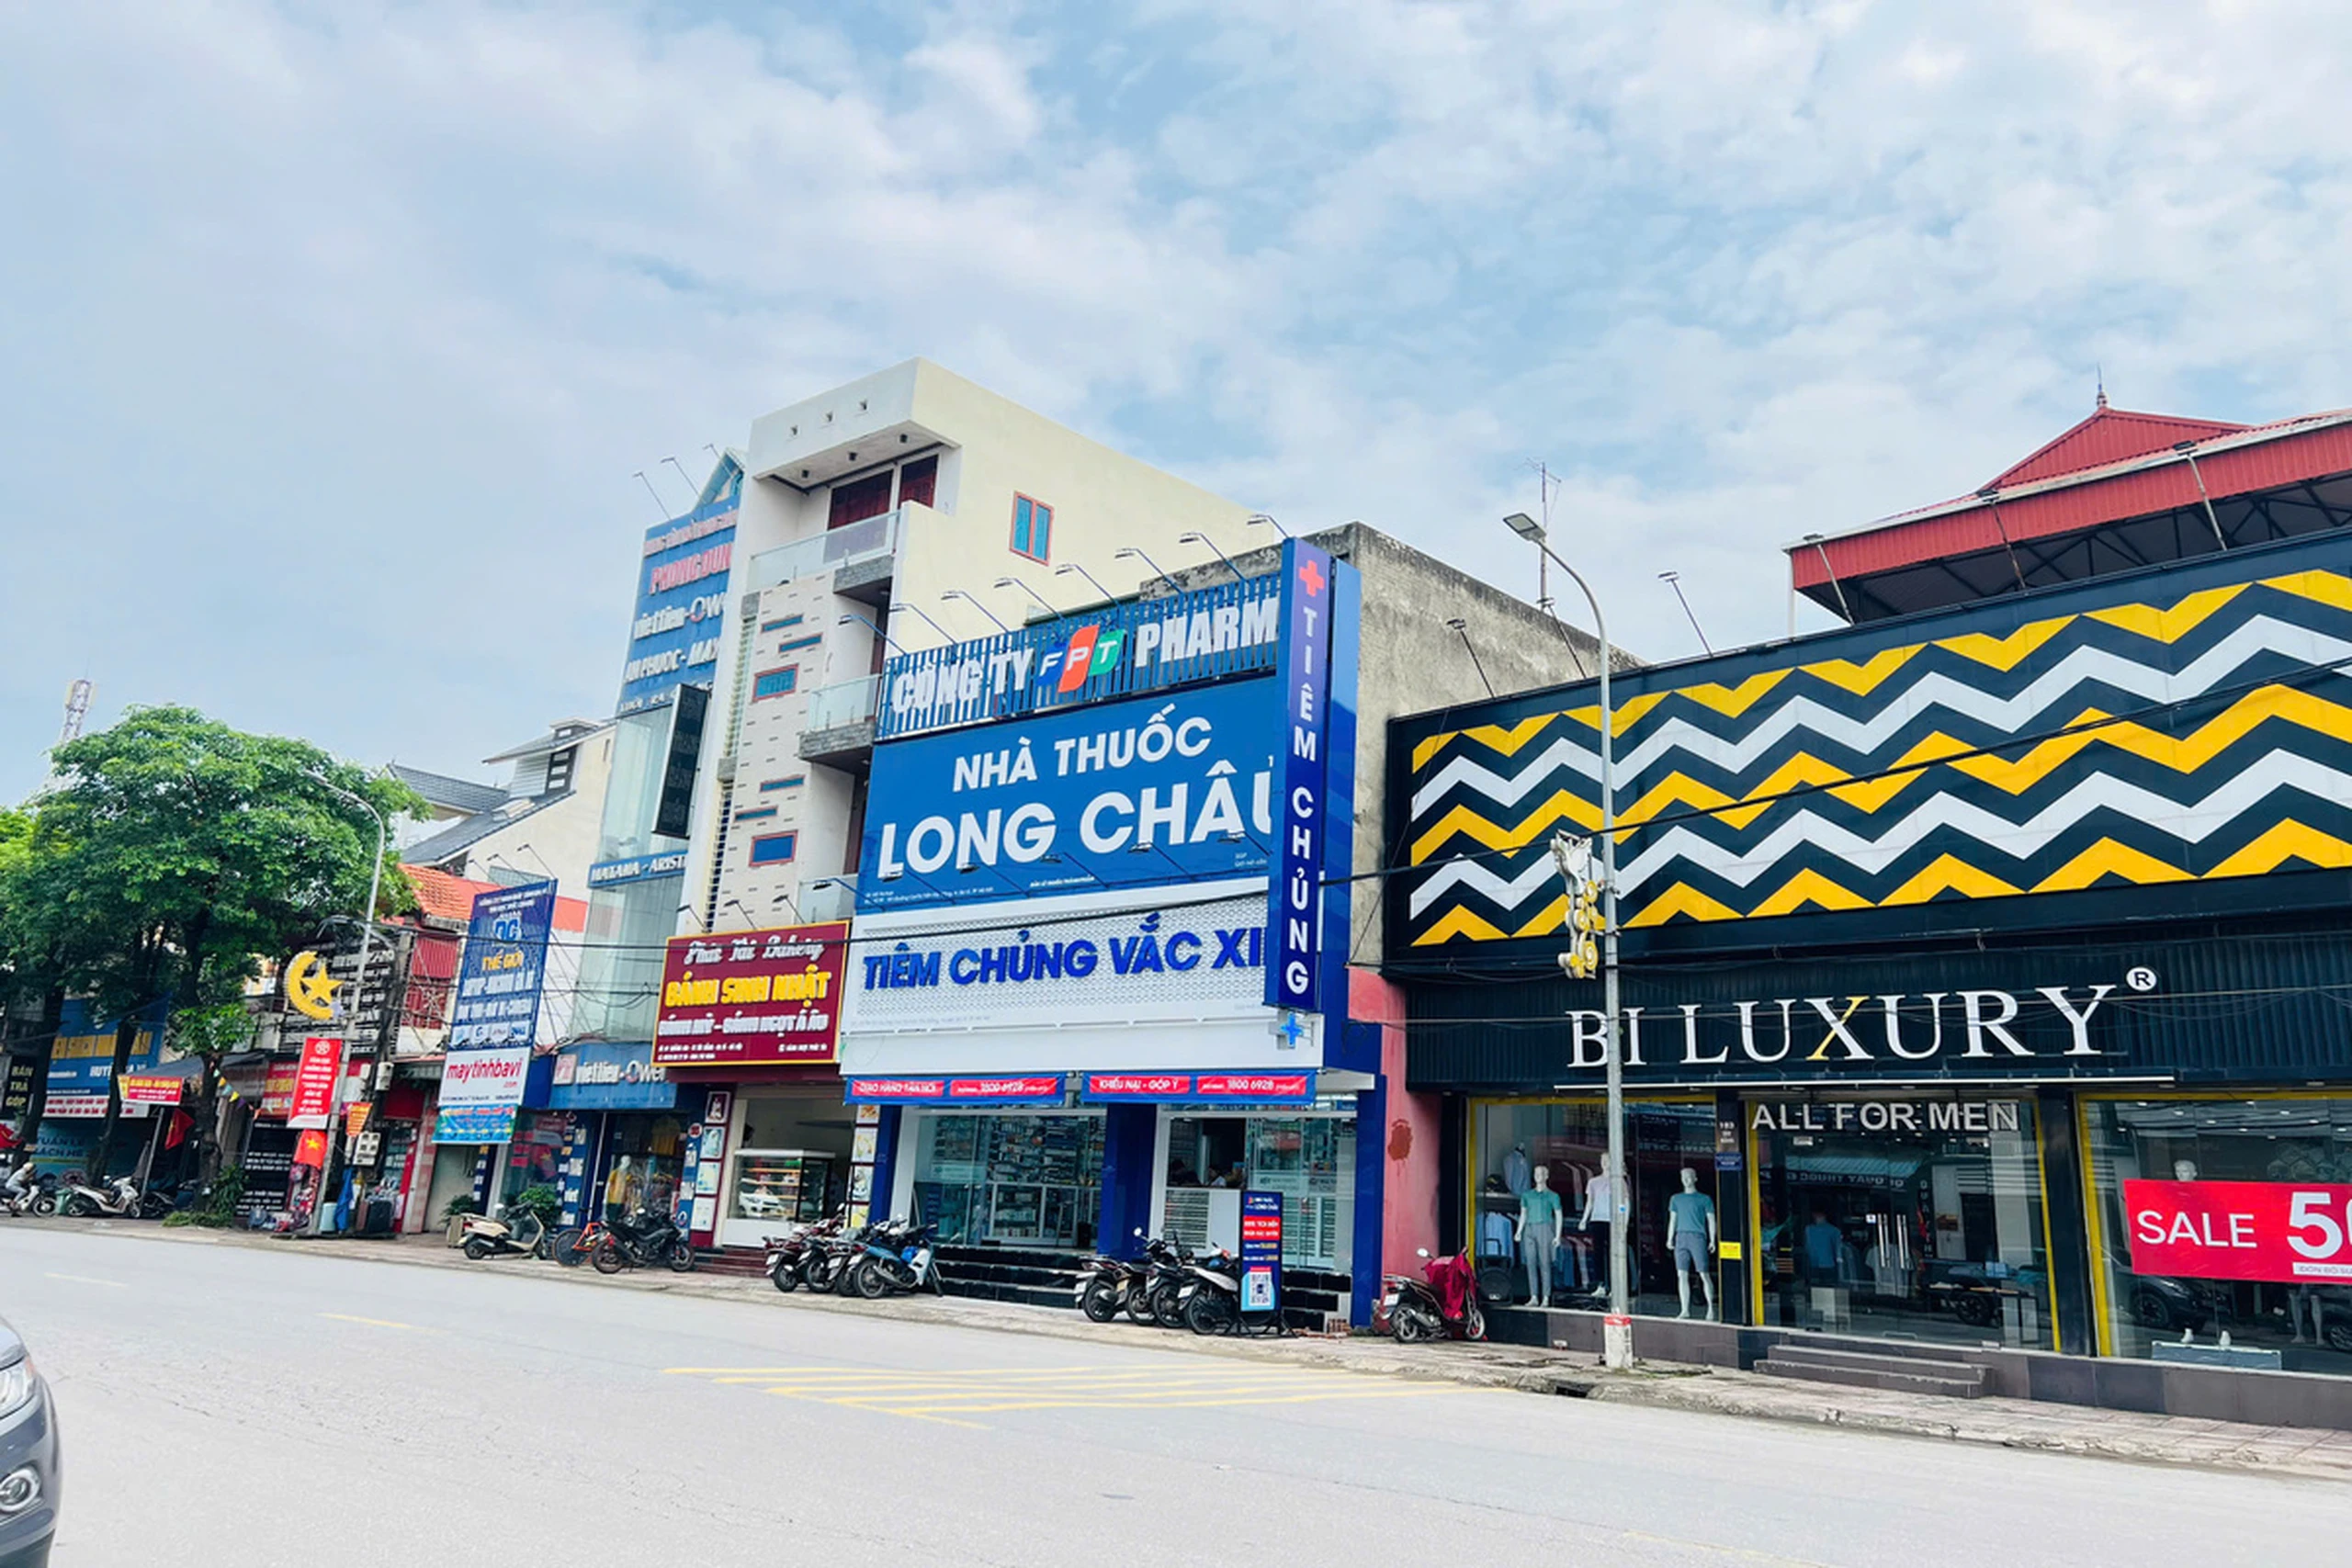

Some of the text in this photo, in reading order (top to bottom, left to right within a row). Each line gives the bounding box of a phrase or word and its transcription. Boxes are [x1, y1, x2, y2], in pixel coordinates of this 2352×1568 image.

[992, 647, 1035, 694] TY
[952, 703, 1212, 793] NHÀ THUỐC
[1286, 606, 1317, 995] TIÊM CHỦNG
[876, 801, 1057, 880] LONG
[664, 963, 832, 1008] BÁNH SINH NHẬT
[863, 912, 1267, 990] TIÊM CHỦNG VẮC XI
[1565, 1008, 1647, 1068] BI
[1678, 985, 2117, 1065] LUXURY
[1227, 1079, 1250, 1090] 1800
[1250, 1079, 1274, 1090] 6928
[1751, 1102, 2019, 1132] ALL FOR MEN
[2137, 1191, 2352, 1259] SALE 5
